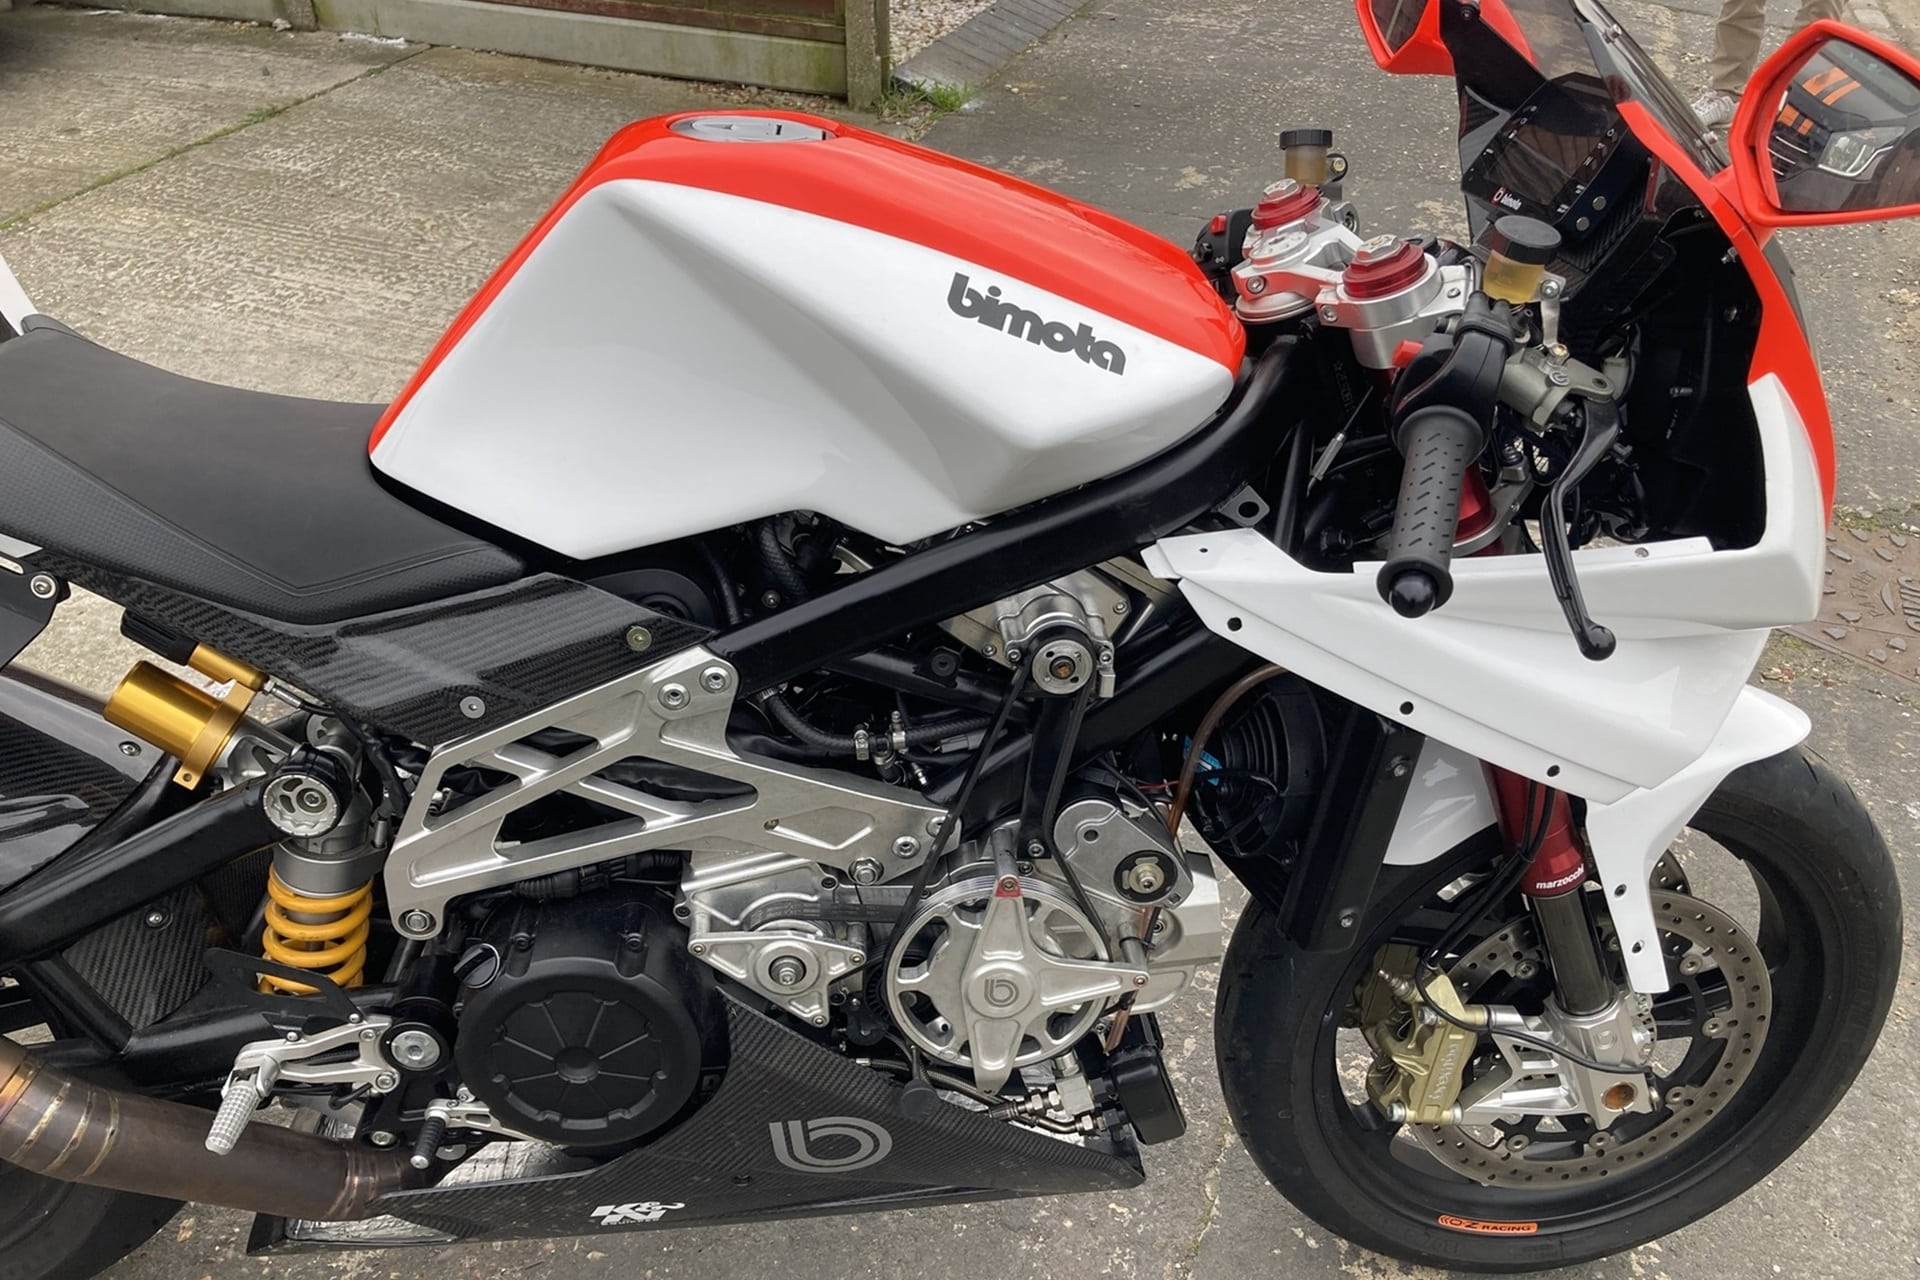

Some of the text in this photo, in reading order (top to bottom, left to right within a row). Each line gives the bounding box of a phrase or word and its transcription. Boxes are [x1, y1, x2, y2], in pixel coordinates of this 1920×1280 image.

[947, 272, 1126, 376] bimota
[1536, 863, 1585, 889] marzocchi
[1481, 1224, 1531, 1232] RACING
